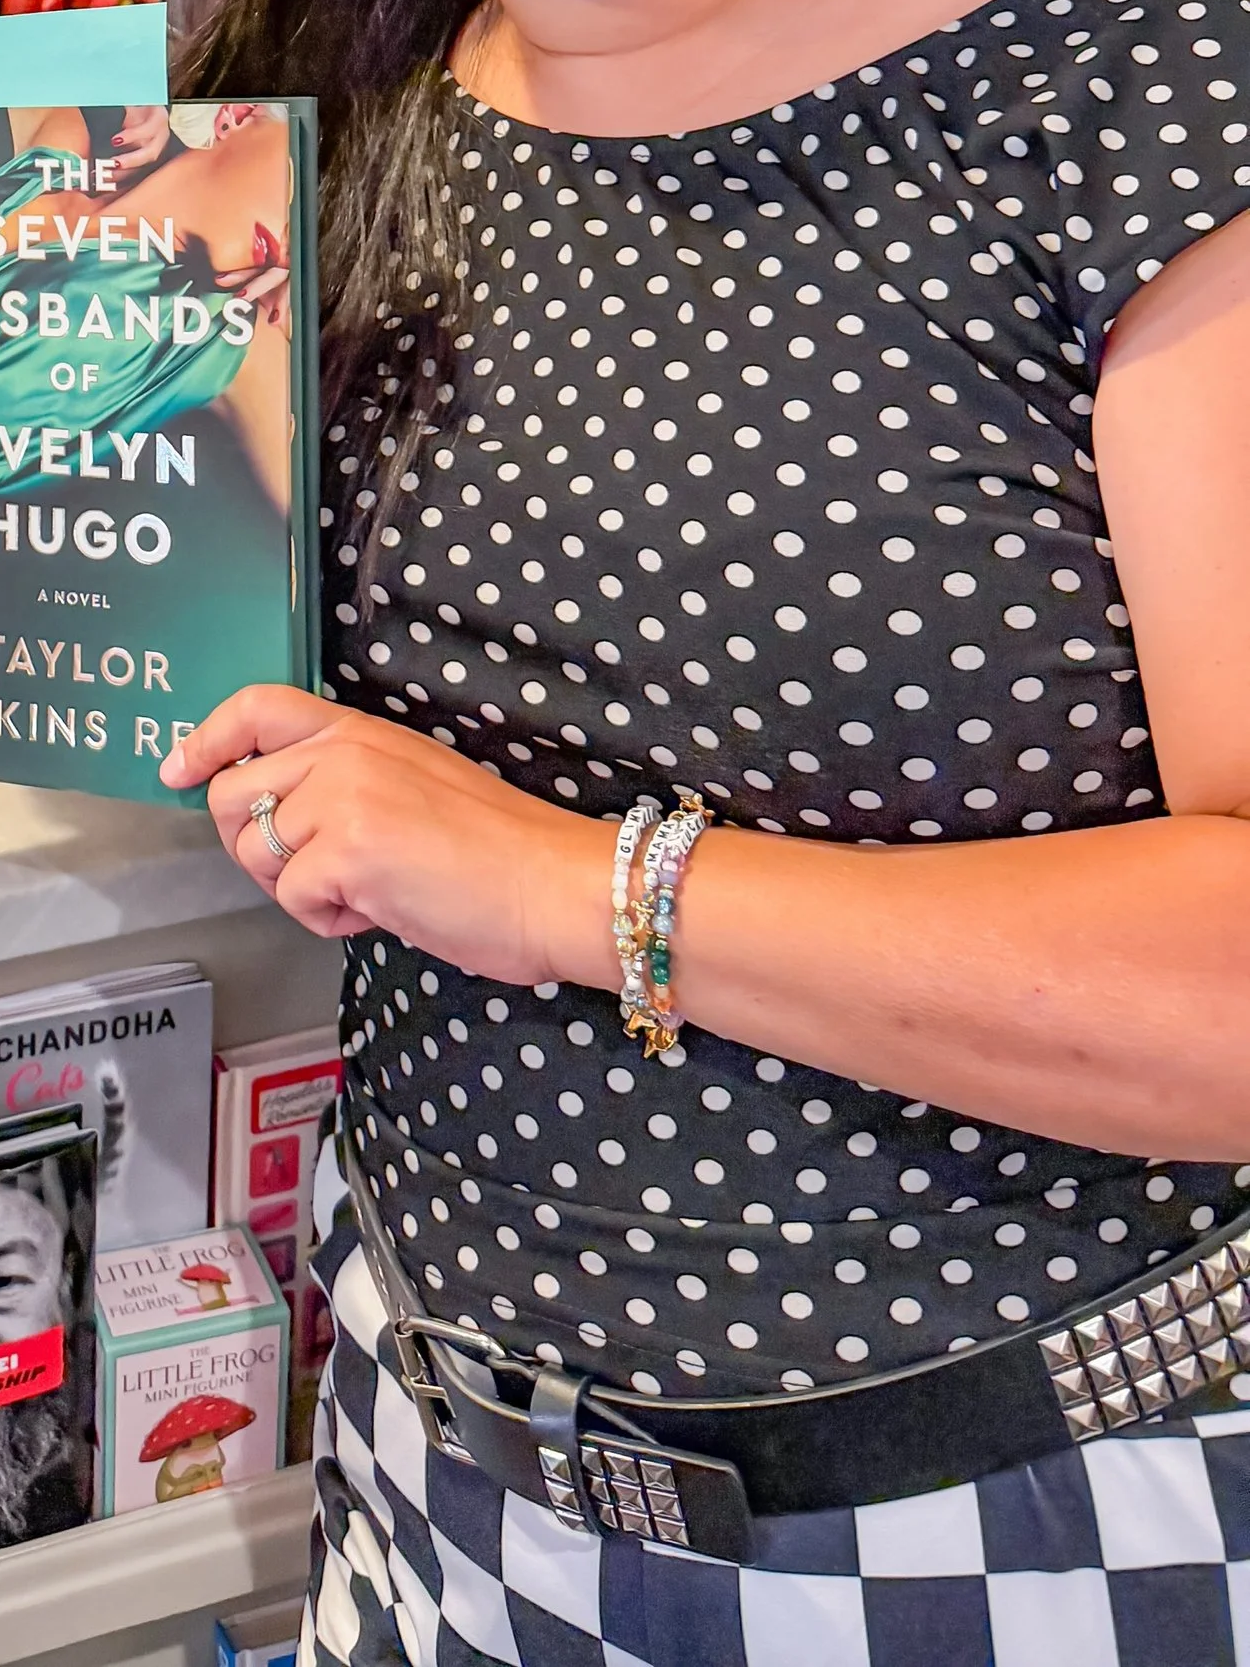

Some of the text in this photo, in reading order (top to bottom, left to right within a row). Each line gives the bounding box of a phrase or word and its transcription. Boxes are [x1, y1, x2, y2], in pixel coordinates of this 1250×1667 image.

[34, 158, 117, 193] THE
[49, 362, 100, 392] OF
[37, 588, 111, 610] A NOVEL
[95, 1242, 247, 1285] LITTLE FROG
[109, 1291, 182, 1318] FIGURINE
[122, 1283, 158, 1300] MINI
[189, 1346, 210, 1359] THE
[123, 1344, 275, 1393] LITTLE FROG
[144, 1371, 254, 1404] MINI FIGURINE
